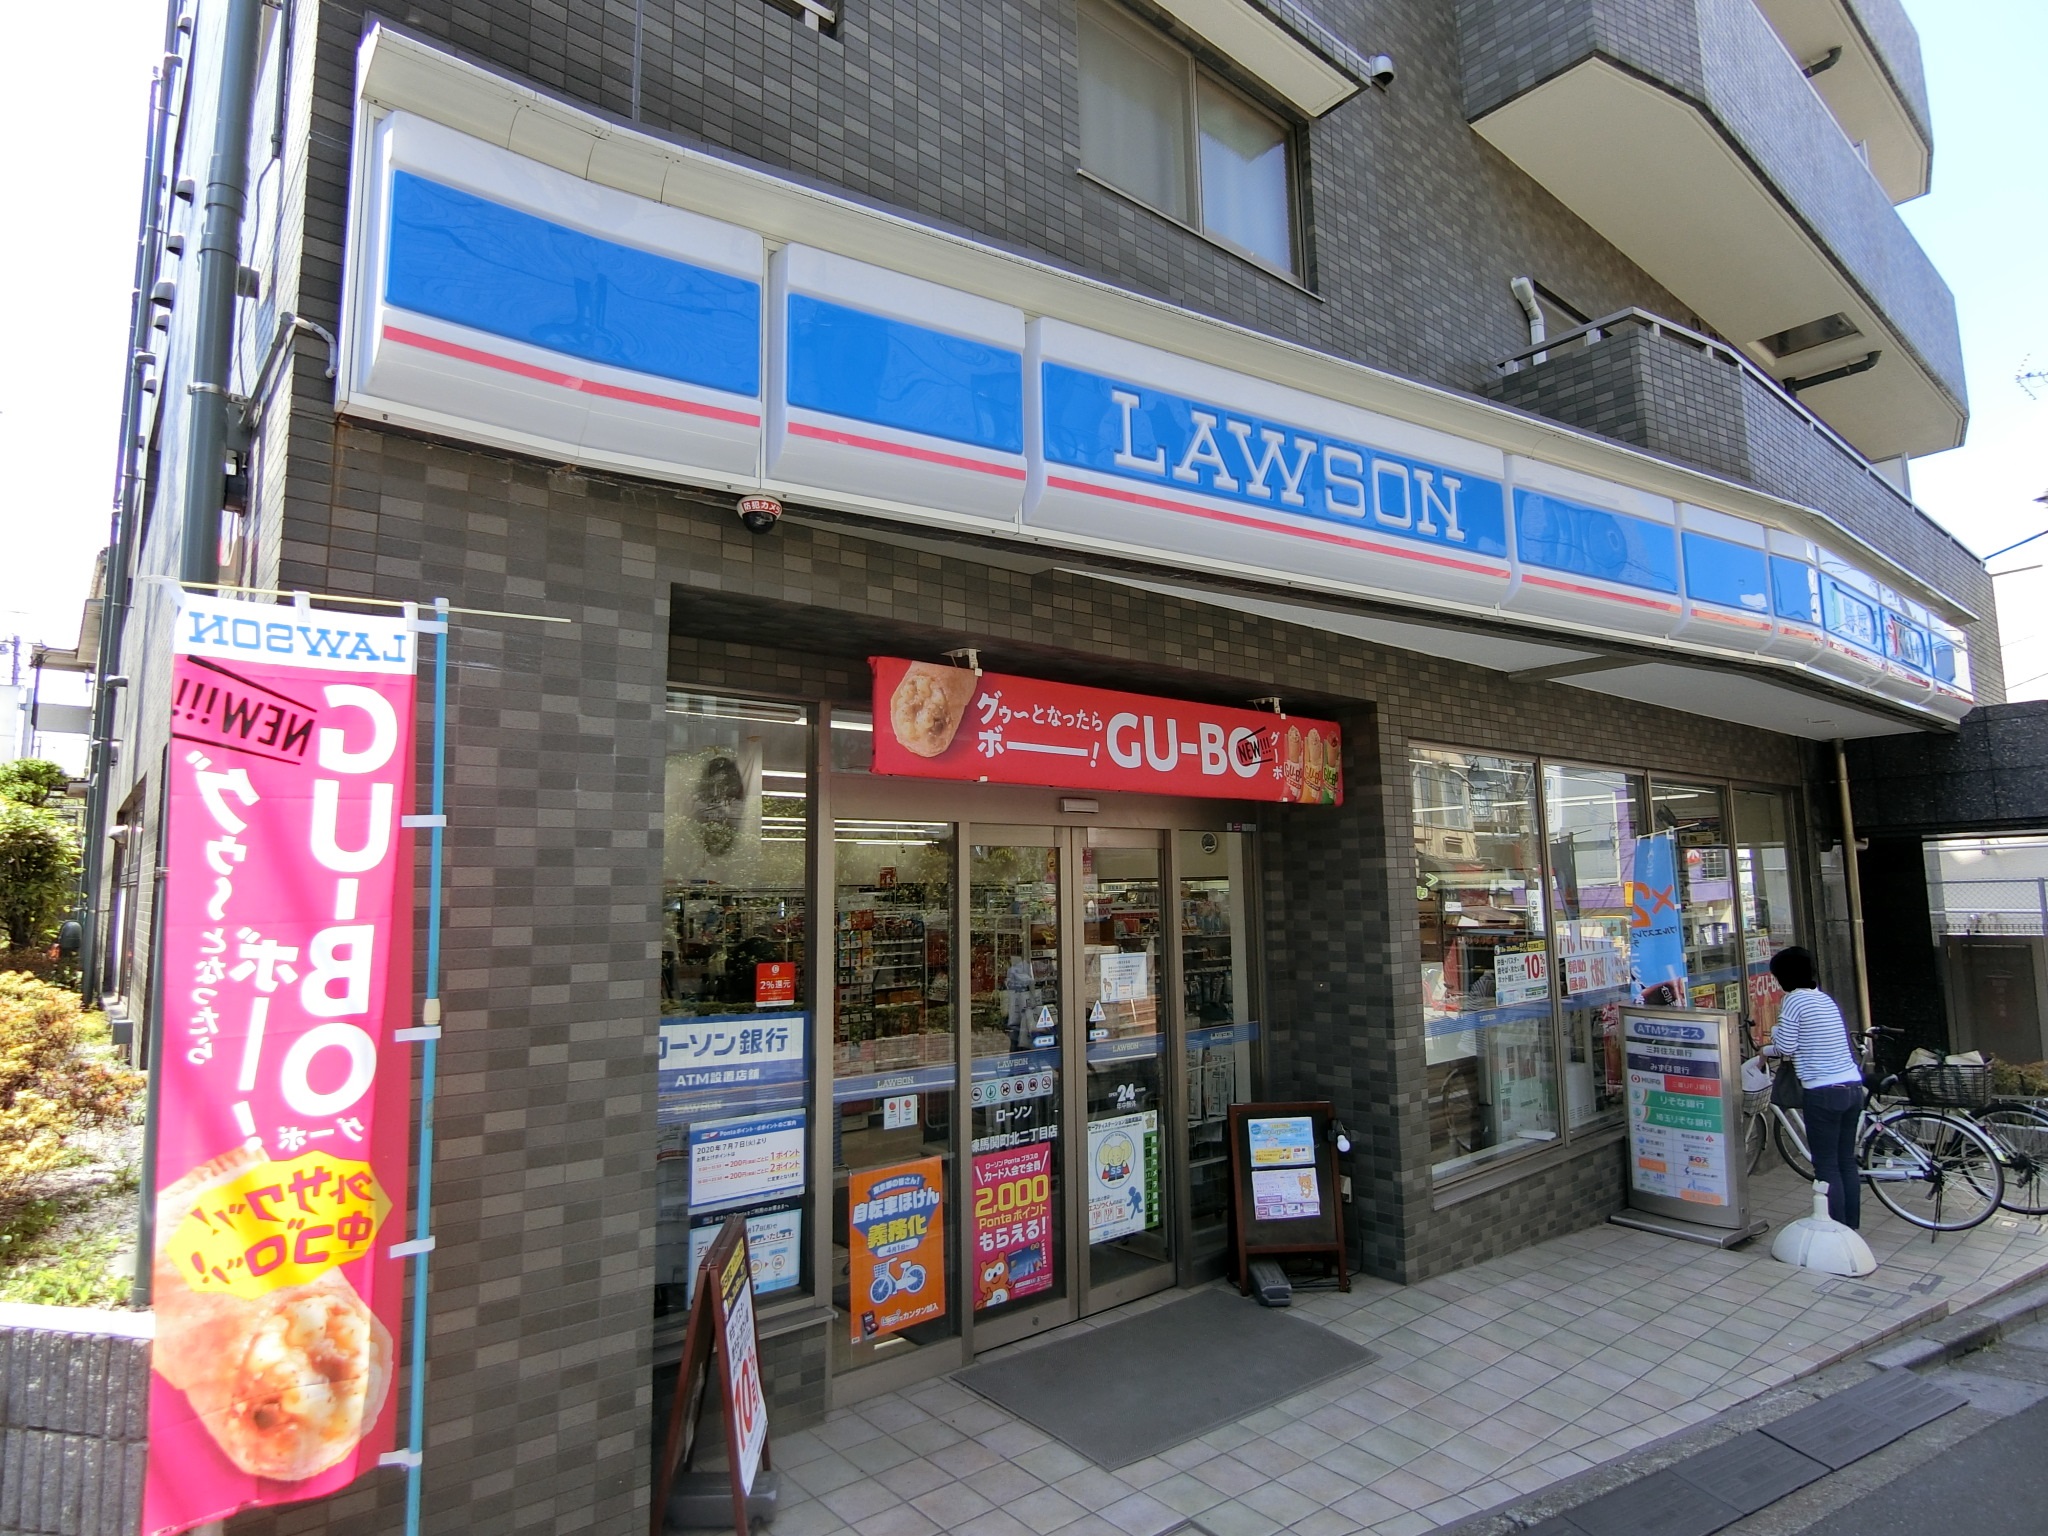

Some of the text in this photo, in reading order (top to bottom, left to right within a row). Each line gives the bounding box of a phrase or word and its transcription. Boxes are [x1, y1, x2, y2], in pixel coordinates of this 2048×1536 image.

[1111, 389, 1465, 542] LAWSON
[743, 500, 781, 514] 防犯カメラ
[1106, 711, 1262, 779] GU-BO
[1525, 954, 1540, 979] 10
[760, 979, 791, 990] 2%還元
[1637, 1024, 1701, 1039] ATMサービス
[1112, 1042, 1139, 1053] LAWSON
[1646, 1045, 1693, 1058] 三井住友銀行
[997, 1057, 1029, 1069] LAWSON
[1649, 1062, 1690, 1075] みずほ銀行
[675, 1068, 760, 1087] ATM設置店舗
[877, 1076, 914, 1089] LAWSON
[1641, 1077, 1661, 1085] MUFG
[1117, 1083, 1136, 1102] 24
[1672, 1082, 1712, 1091] 三菱UFJ銀行
[1660, 1095, 1705, 1110] りそな銀行
[995, 1105, 1033, 1122] ローソン
[1655, 1113, 1712, 1128] 埼玉りそな銀行
[984, 1160, 1042, 1183] カード入会で全員
[1110, 1166, 1122, 1175] SS
[975, 1174, 1049, 1218] 2,000
[852, 1187, 940, 1225] 自転車ほけん
[867, 1213, 928, 1249] 義務化
[979, 1216, 1046, 1252] もらえる!
